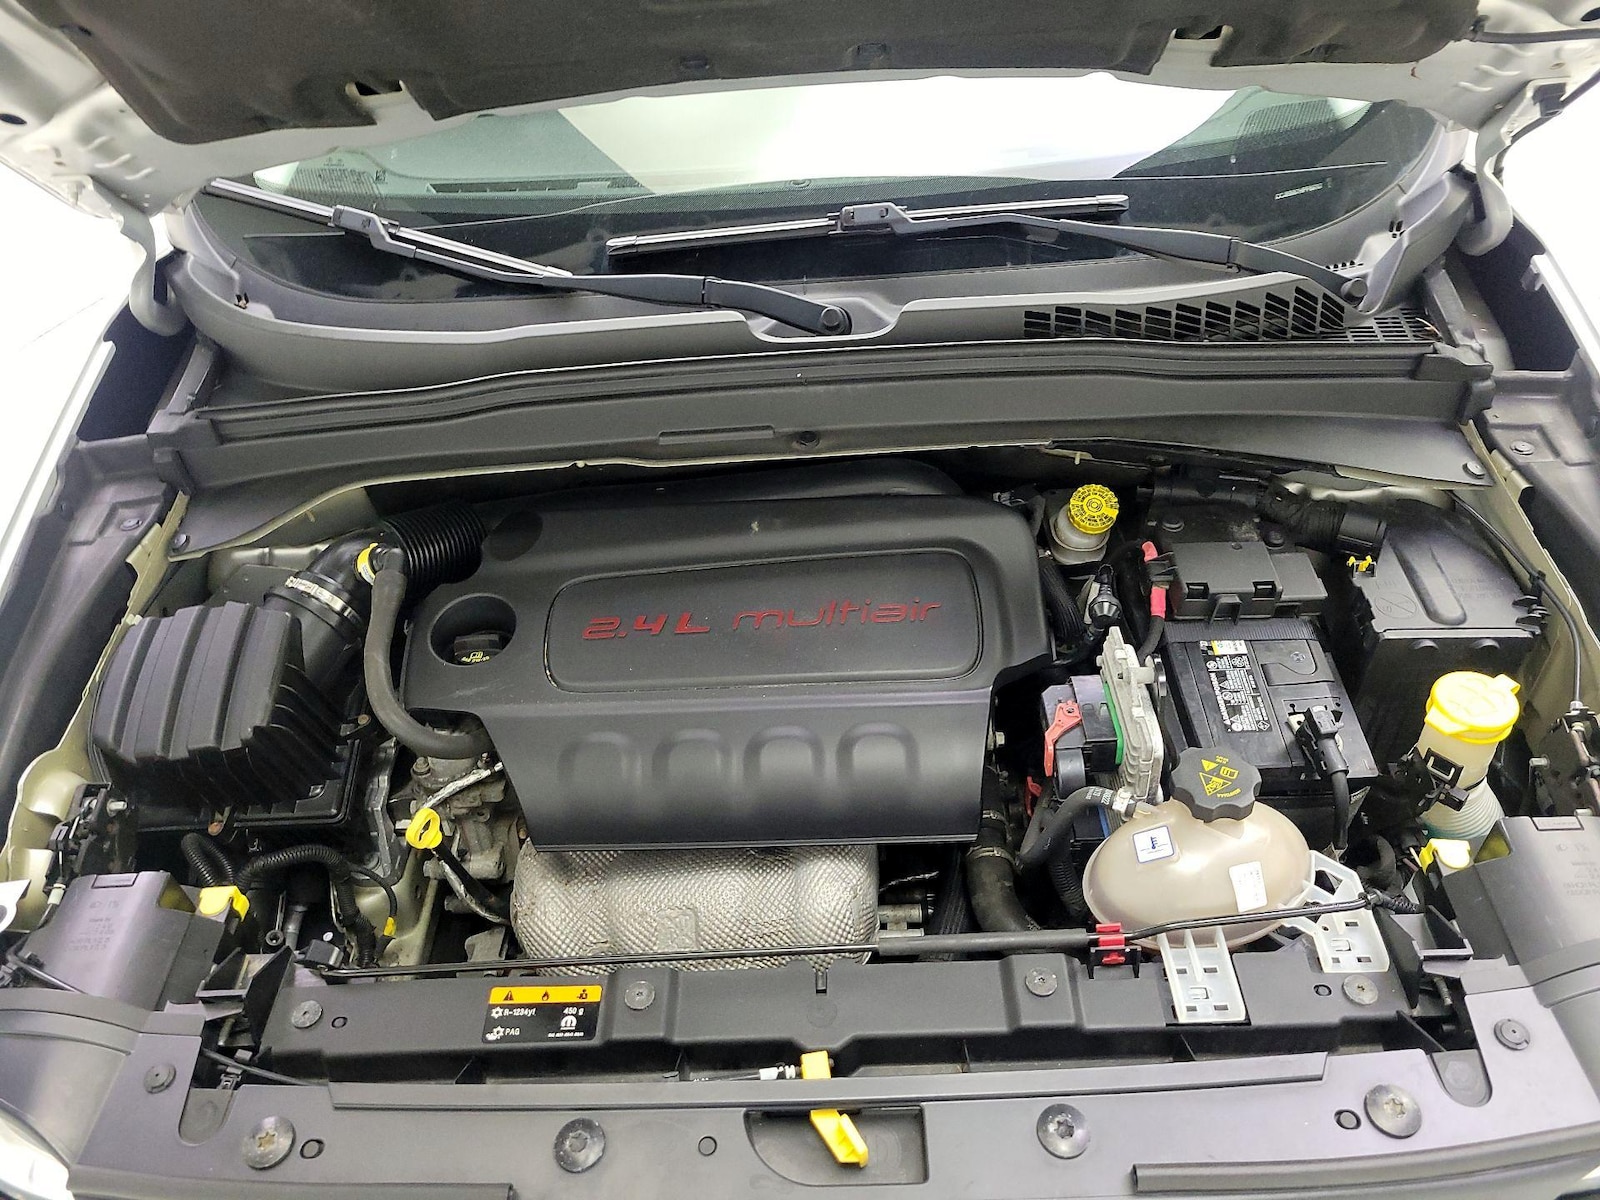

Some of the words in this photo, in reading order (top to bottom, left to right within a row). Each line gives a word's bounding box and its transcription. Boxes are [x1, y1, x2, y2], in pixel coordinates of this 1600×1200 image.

[732, 599, 942, 630] multiair
[503, 1007, 537, 1017] R-1234yf
[563, 1007, 577, 1015] 450
[505, 1027, 520, 1036] PAG
